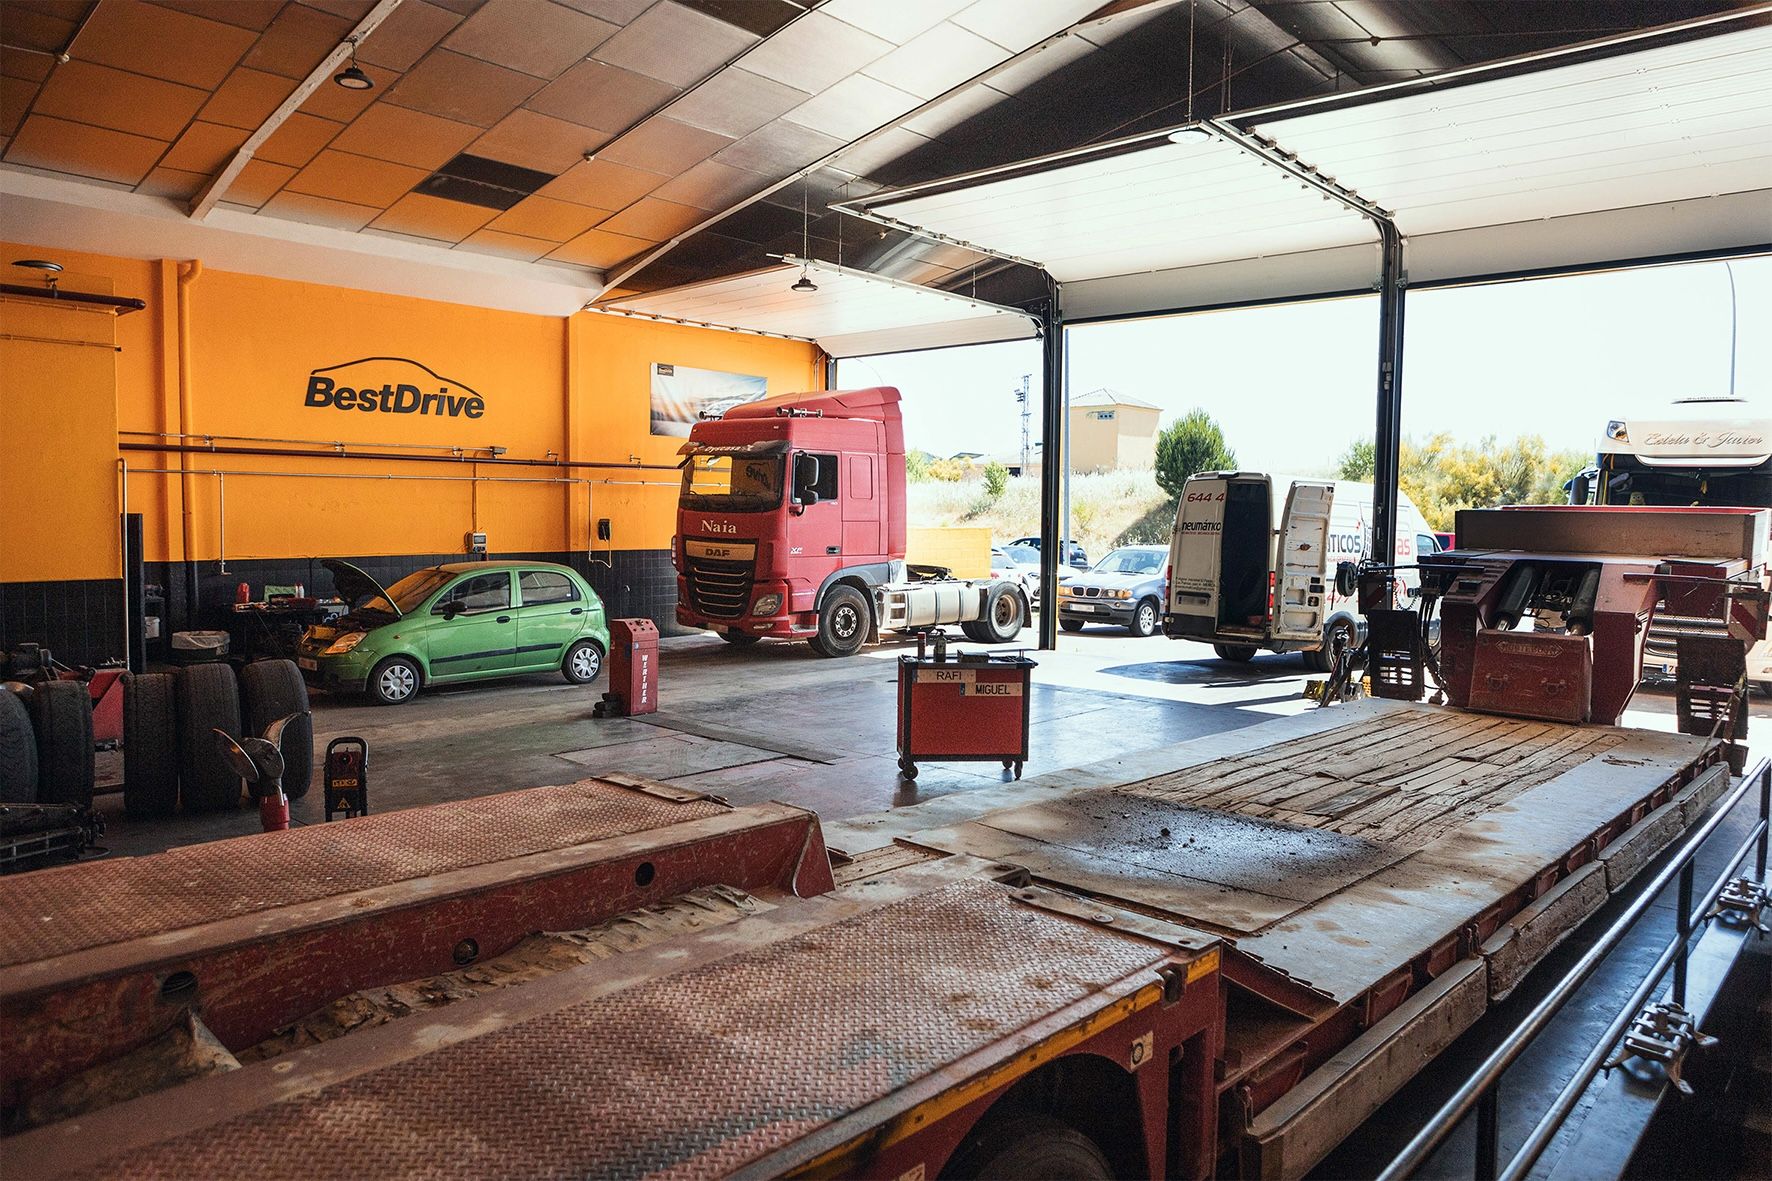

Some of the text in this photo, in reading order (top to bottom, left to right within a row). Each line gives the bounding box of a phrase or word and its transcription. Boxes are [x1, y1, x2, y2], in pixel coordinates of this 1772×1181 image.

[304, 375, 485, 419] BestDrive
[1187, 492, 1212, 502] 644
[700, 519, 737, 534] Naia
[705, 548, 731, 557] DAF
[936, 671, 962, 681] RAFI
[975, 684, 1010, 695] MIGUEL
